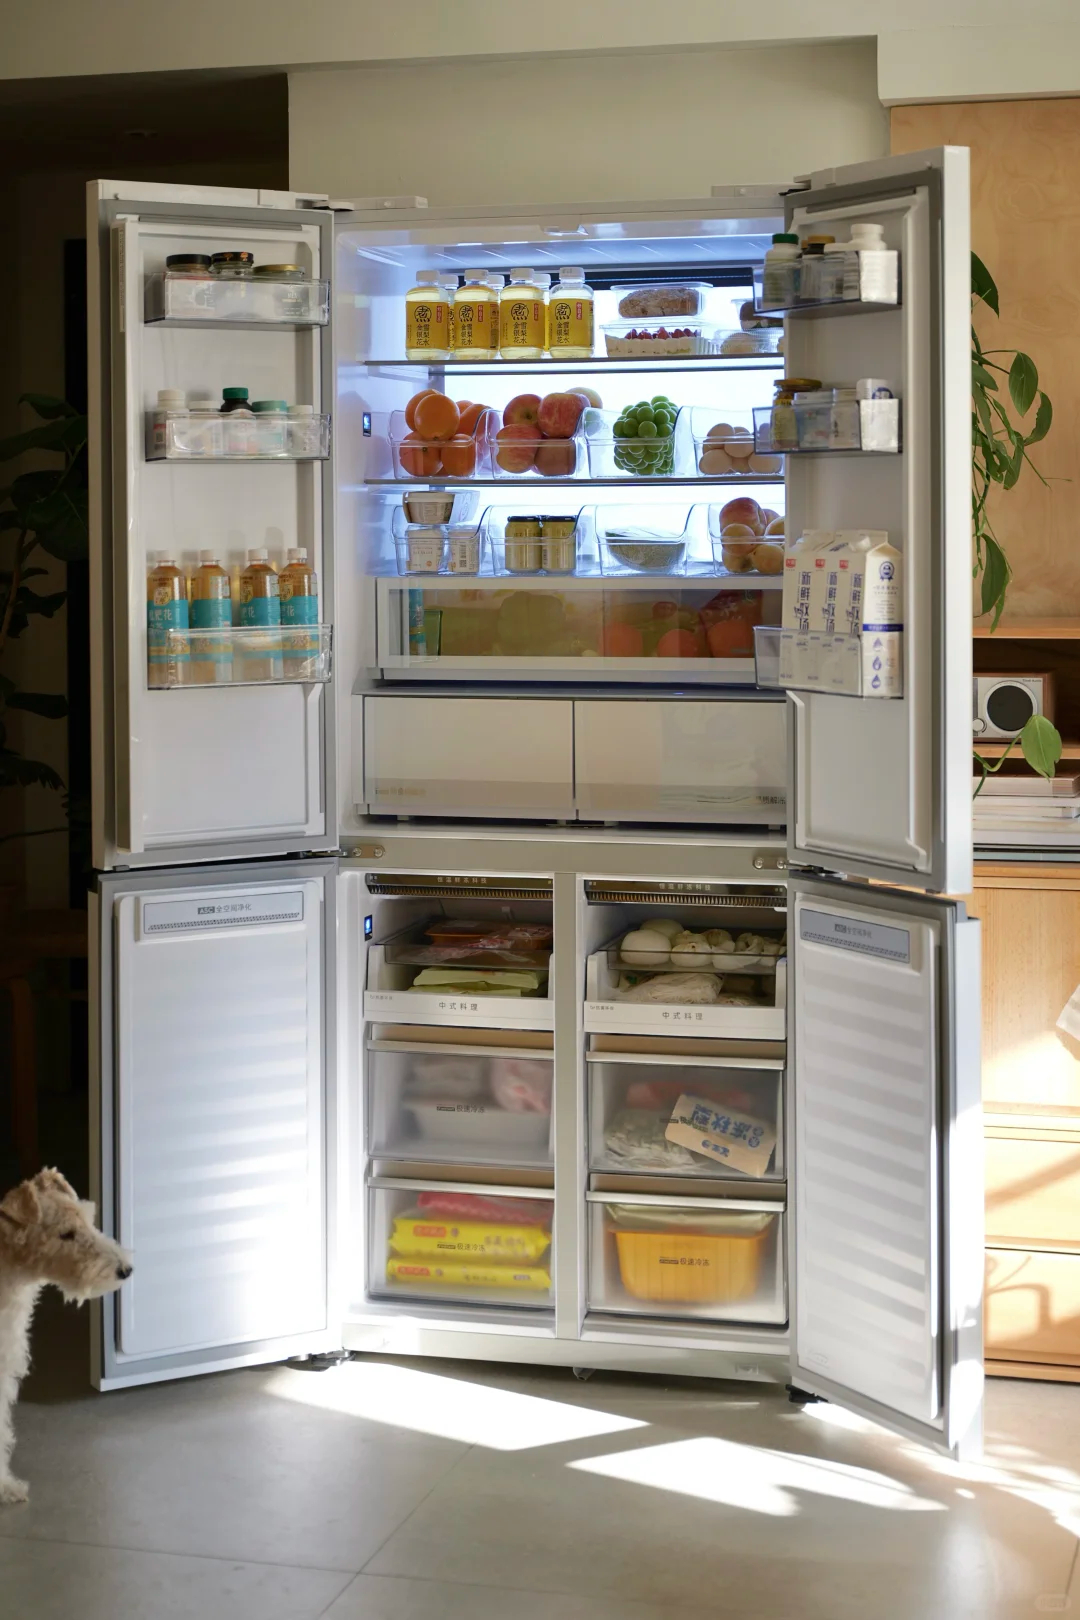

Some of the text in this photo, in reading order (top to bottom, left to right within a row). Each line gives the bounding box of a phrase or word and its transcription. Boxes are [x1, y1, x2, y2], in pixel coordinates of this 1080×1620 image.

[438, 1001, 478, 1011] 中式料理
[662, 1011, 703, 1021] 中式料理
[456, 1103, 485, 1113] 极速冷冻
[457, 1242, 486, 1252] 极速冷冻
[680, 1257, 710, 1267] 极速冷冻
